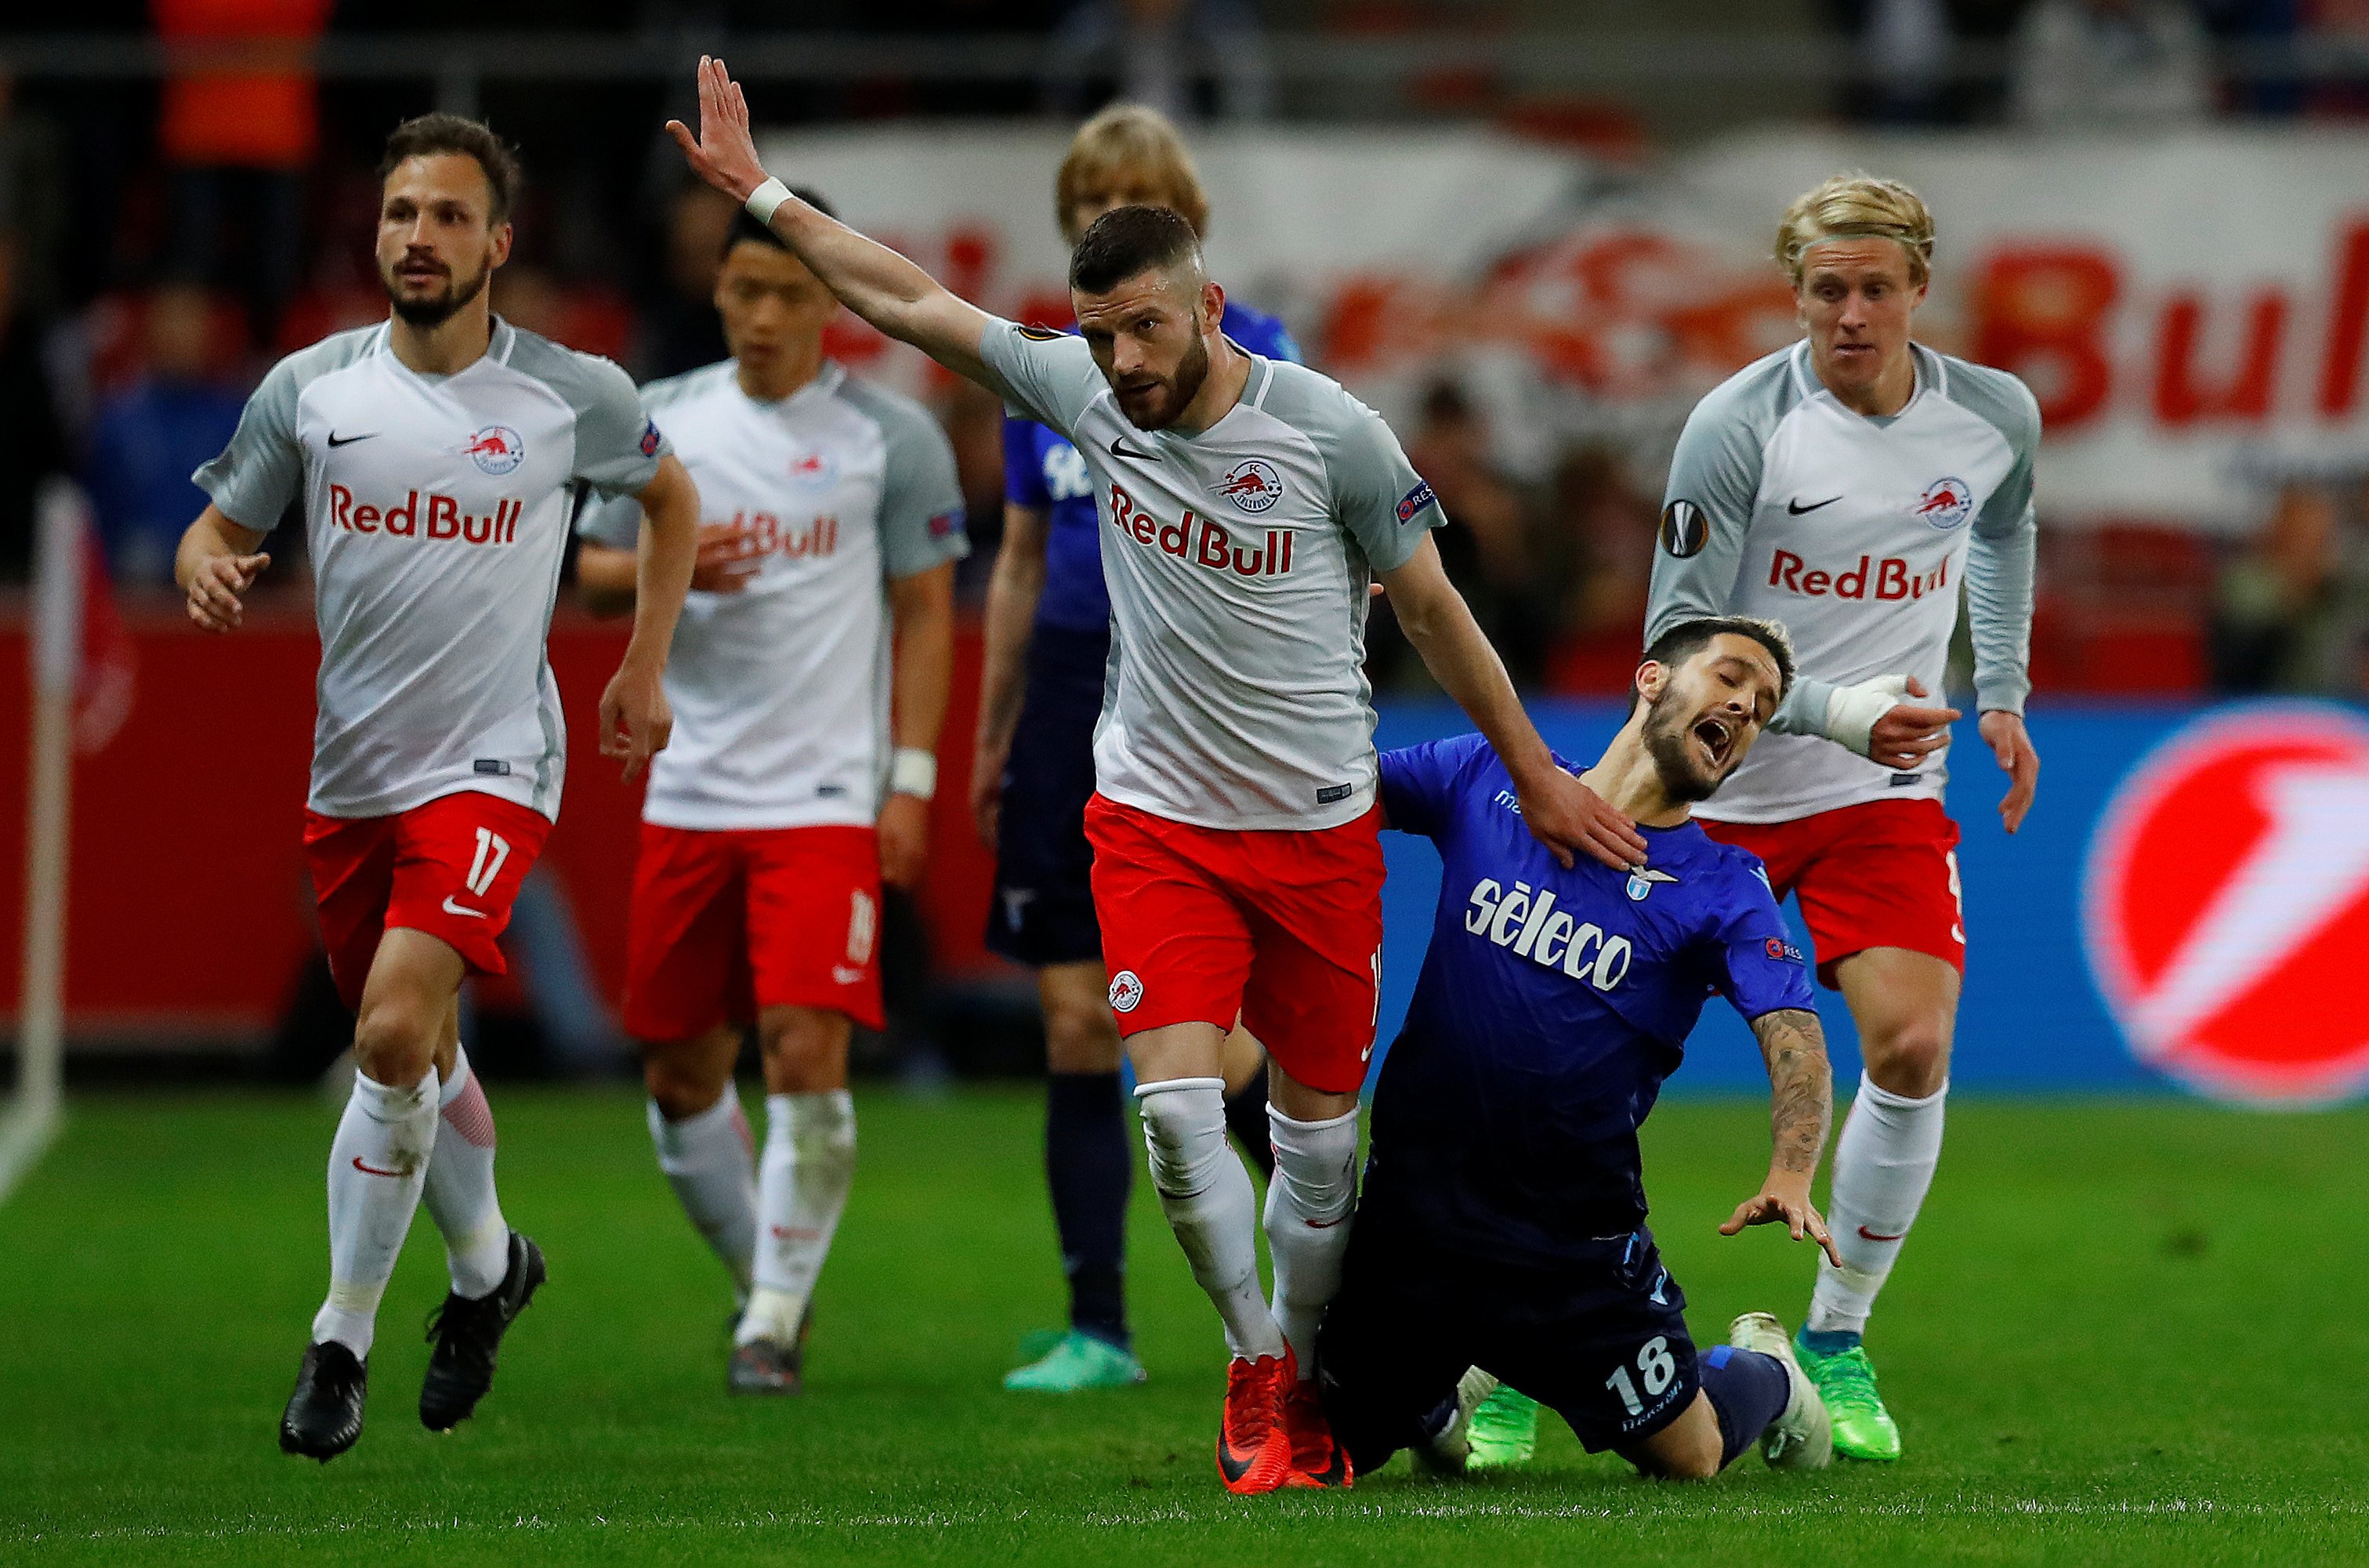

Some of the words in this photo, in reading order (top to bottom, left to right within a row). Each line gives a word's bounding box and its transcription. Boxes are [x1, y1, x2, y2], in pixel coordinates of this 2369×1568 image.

[1249, 464, 1260, 473] FC
[330, 483, 418, 537] Red
[428, 495, 523, 545] Bull
[1111, 483, 1194, 559] Red
[1197, 519, 1293, 576] Bull
[1770, 549, 1870, 599] Red
[465, 825, 512, 897] 17
[1606, 1335, 1675, 1417] 18
